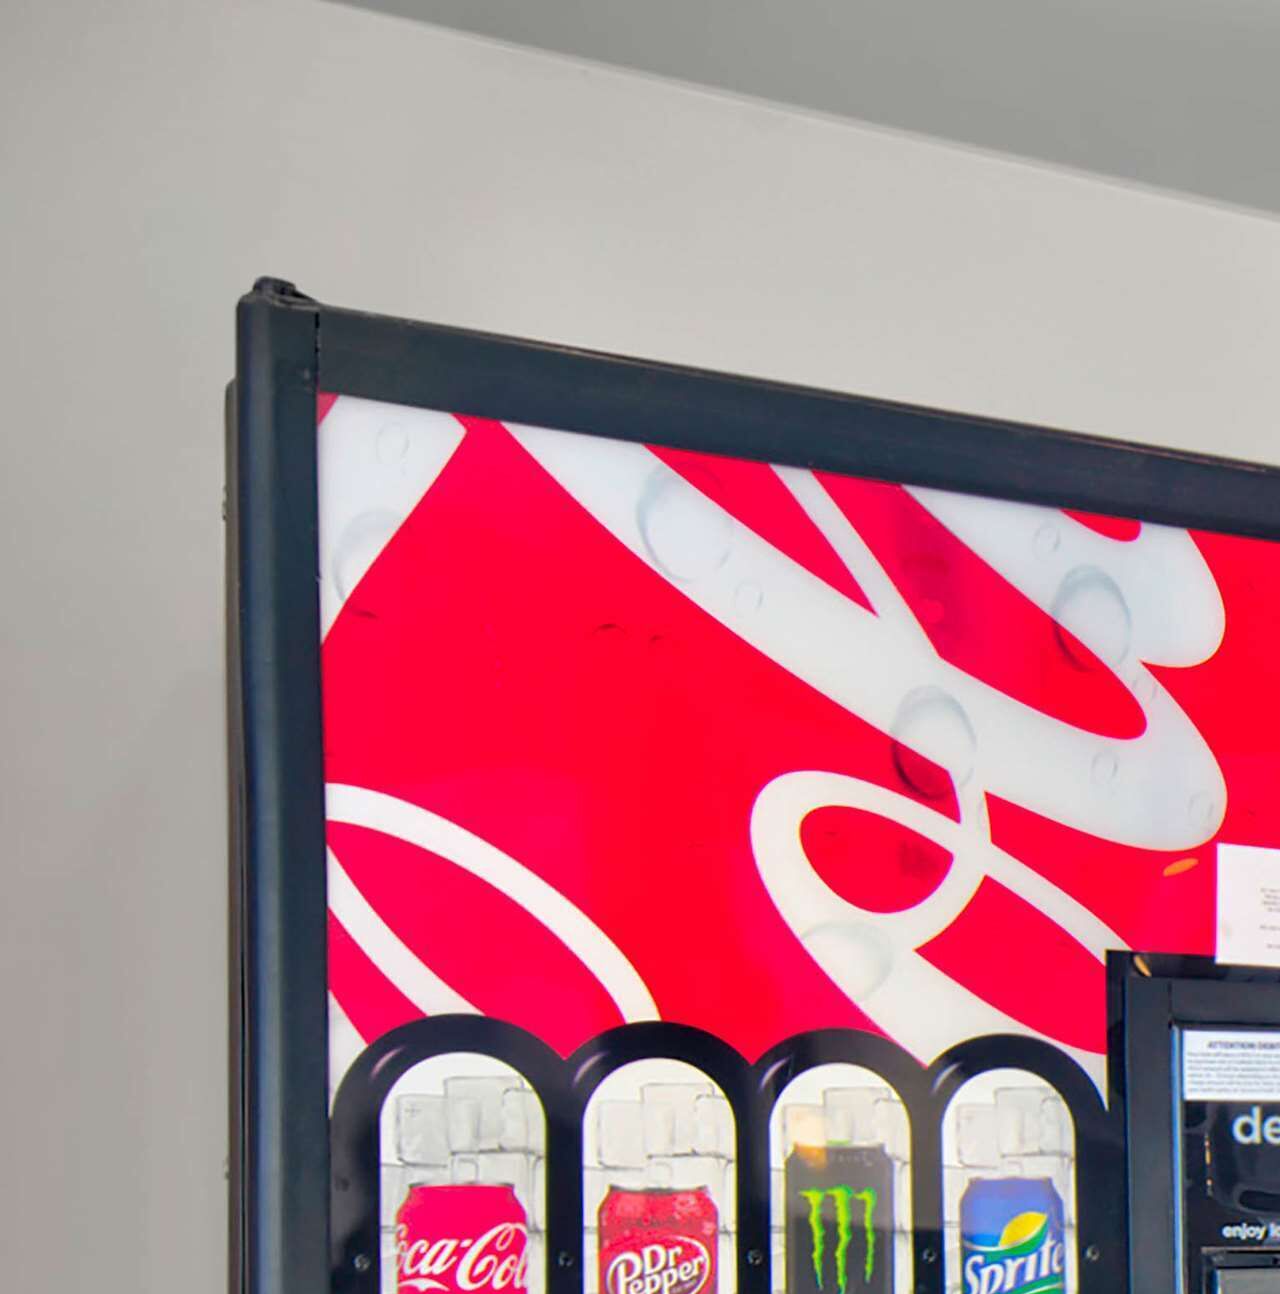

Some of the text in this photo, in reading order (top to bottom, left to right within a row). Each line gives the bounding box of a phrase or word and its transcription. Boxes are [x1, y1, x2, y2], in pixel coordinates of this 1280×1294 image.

[1208, 1041, 1256, 1050] ATTENTION
[1221, 1222, 1267, 1242] enjoy
[642, 1244, 682, 1276] Dr
